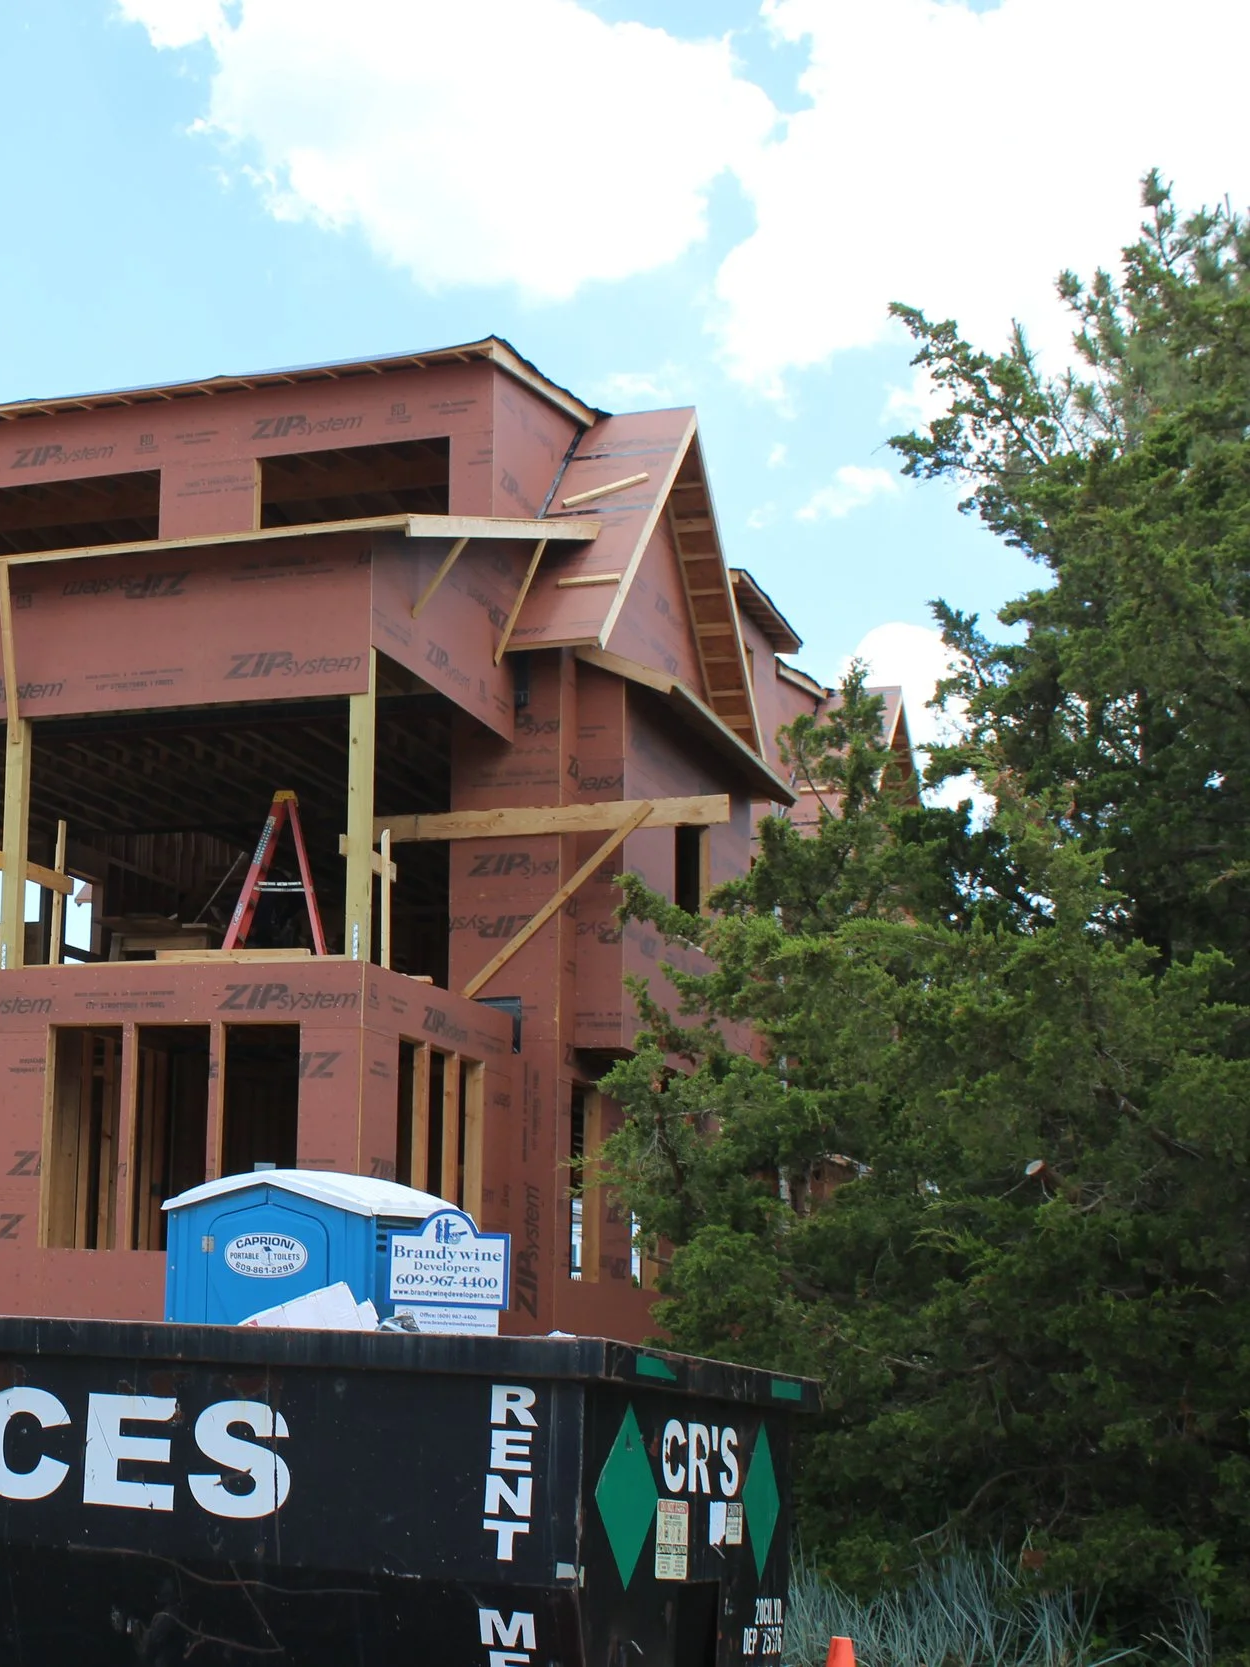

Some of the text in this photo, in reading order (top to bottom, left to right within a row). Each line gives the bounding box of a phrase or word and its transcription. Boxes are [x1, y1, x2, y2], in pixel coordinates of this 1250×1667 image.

[235, 1236, 295, 1251] CAPRIONI
[230, 1252, 301, 1261] PORTABLE TOILETS
[393, 1244, 502, 1264] Brandywine
[414, 1261, 481, 1274] Developers
[396, 1273, 498, 1289] 609-967-4400
[393, 1288, 501, 1300] www.brandywinedevelopers.com
[662, 1418, 740, 1497] CR'S
[483, 1384, 538, 1561] RENT
[743, 1627, 758, 1655] DEP
